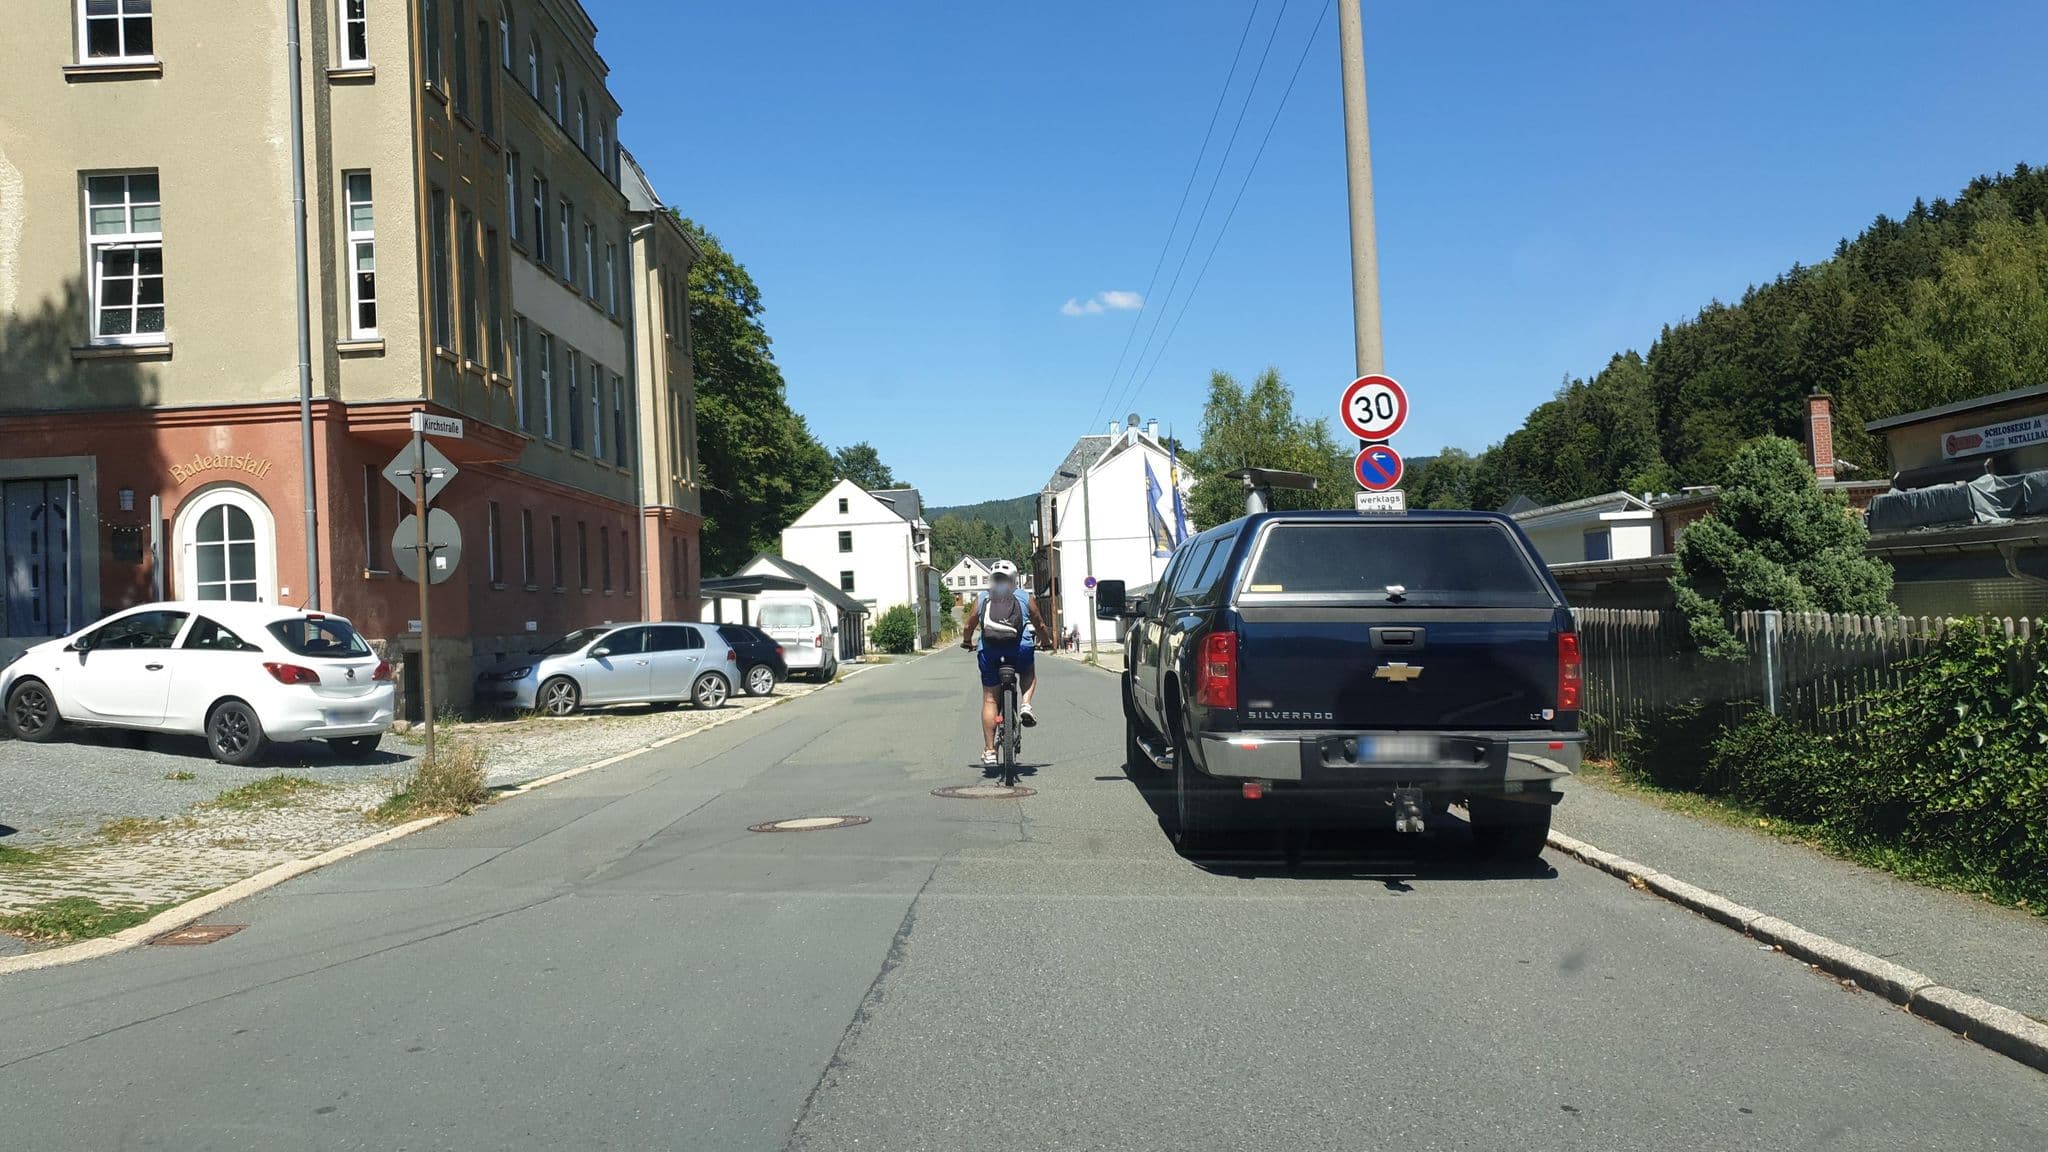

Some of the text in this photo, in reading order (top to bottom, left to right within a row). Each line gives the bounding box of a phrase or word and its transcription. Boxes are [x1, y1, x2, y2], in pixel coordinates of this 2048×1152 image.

[1355, 392, 1393, 424] 30
[424, 417, 460, 434] Kirchstraße
[1984, 421, 2032, 438] SCHLOSSEREI
[168, 452, 272, 486] Badeanstalt
[1360, 494, 1401, 504] werktags
[1248, 711, 1333, 720] SILVERADO
